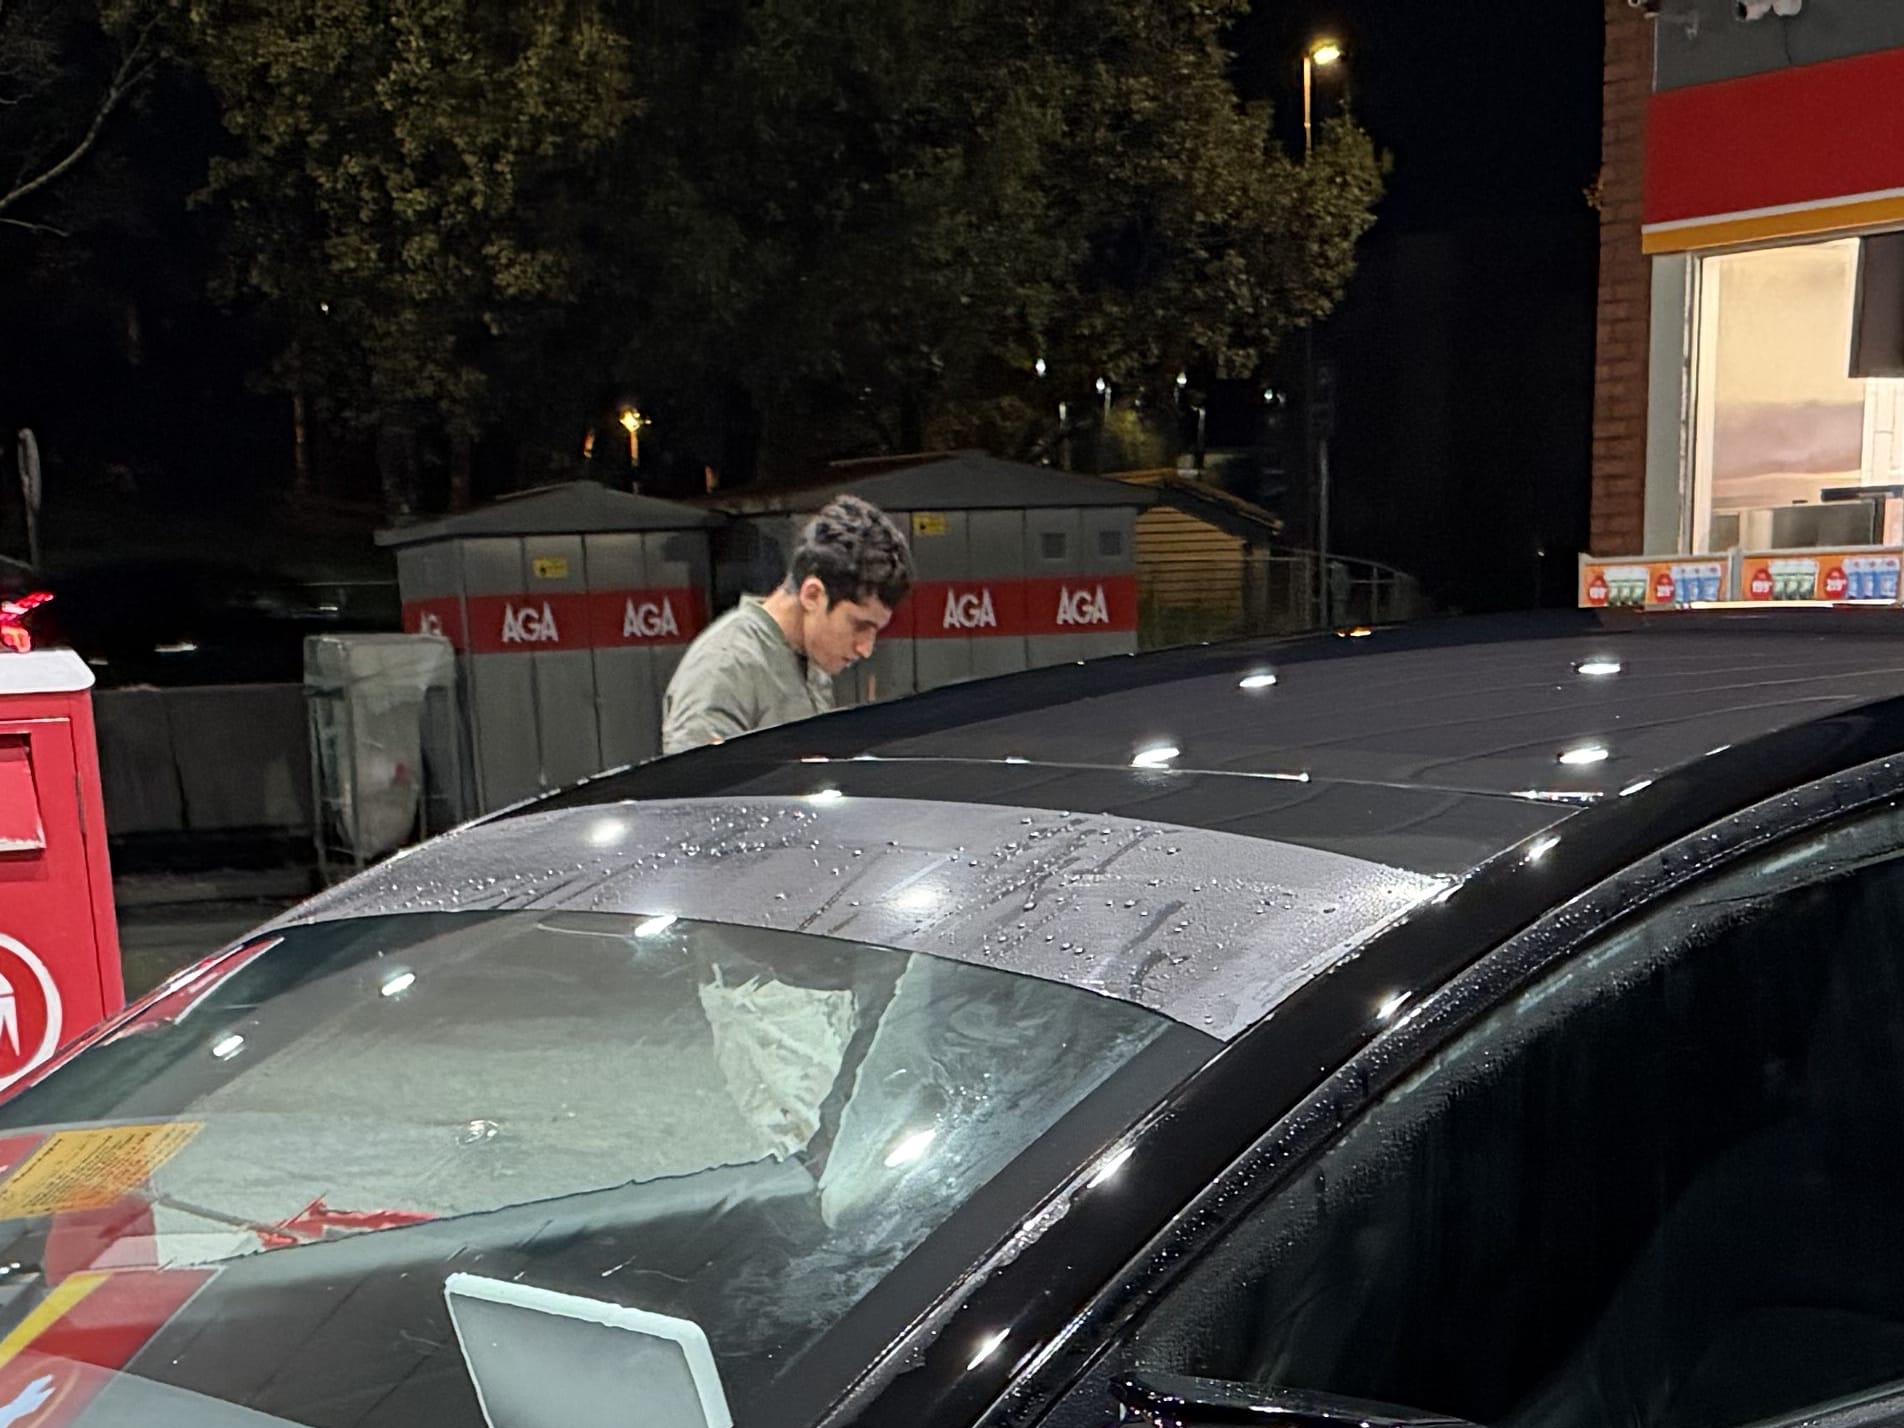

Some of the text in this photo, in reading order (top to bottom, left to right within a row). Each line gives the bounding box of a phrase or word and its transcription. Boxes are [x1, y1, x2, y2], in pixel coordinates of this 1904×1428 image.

[501, 602, 559, 643] AGA
[623, 596, 679, 638] AGA
[943, 588, 996, 629] AGA
[1056, 585, 1109, 625] AGA
